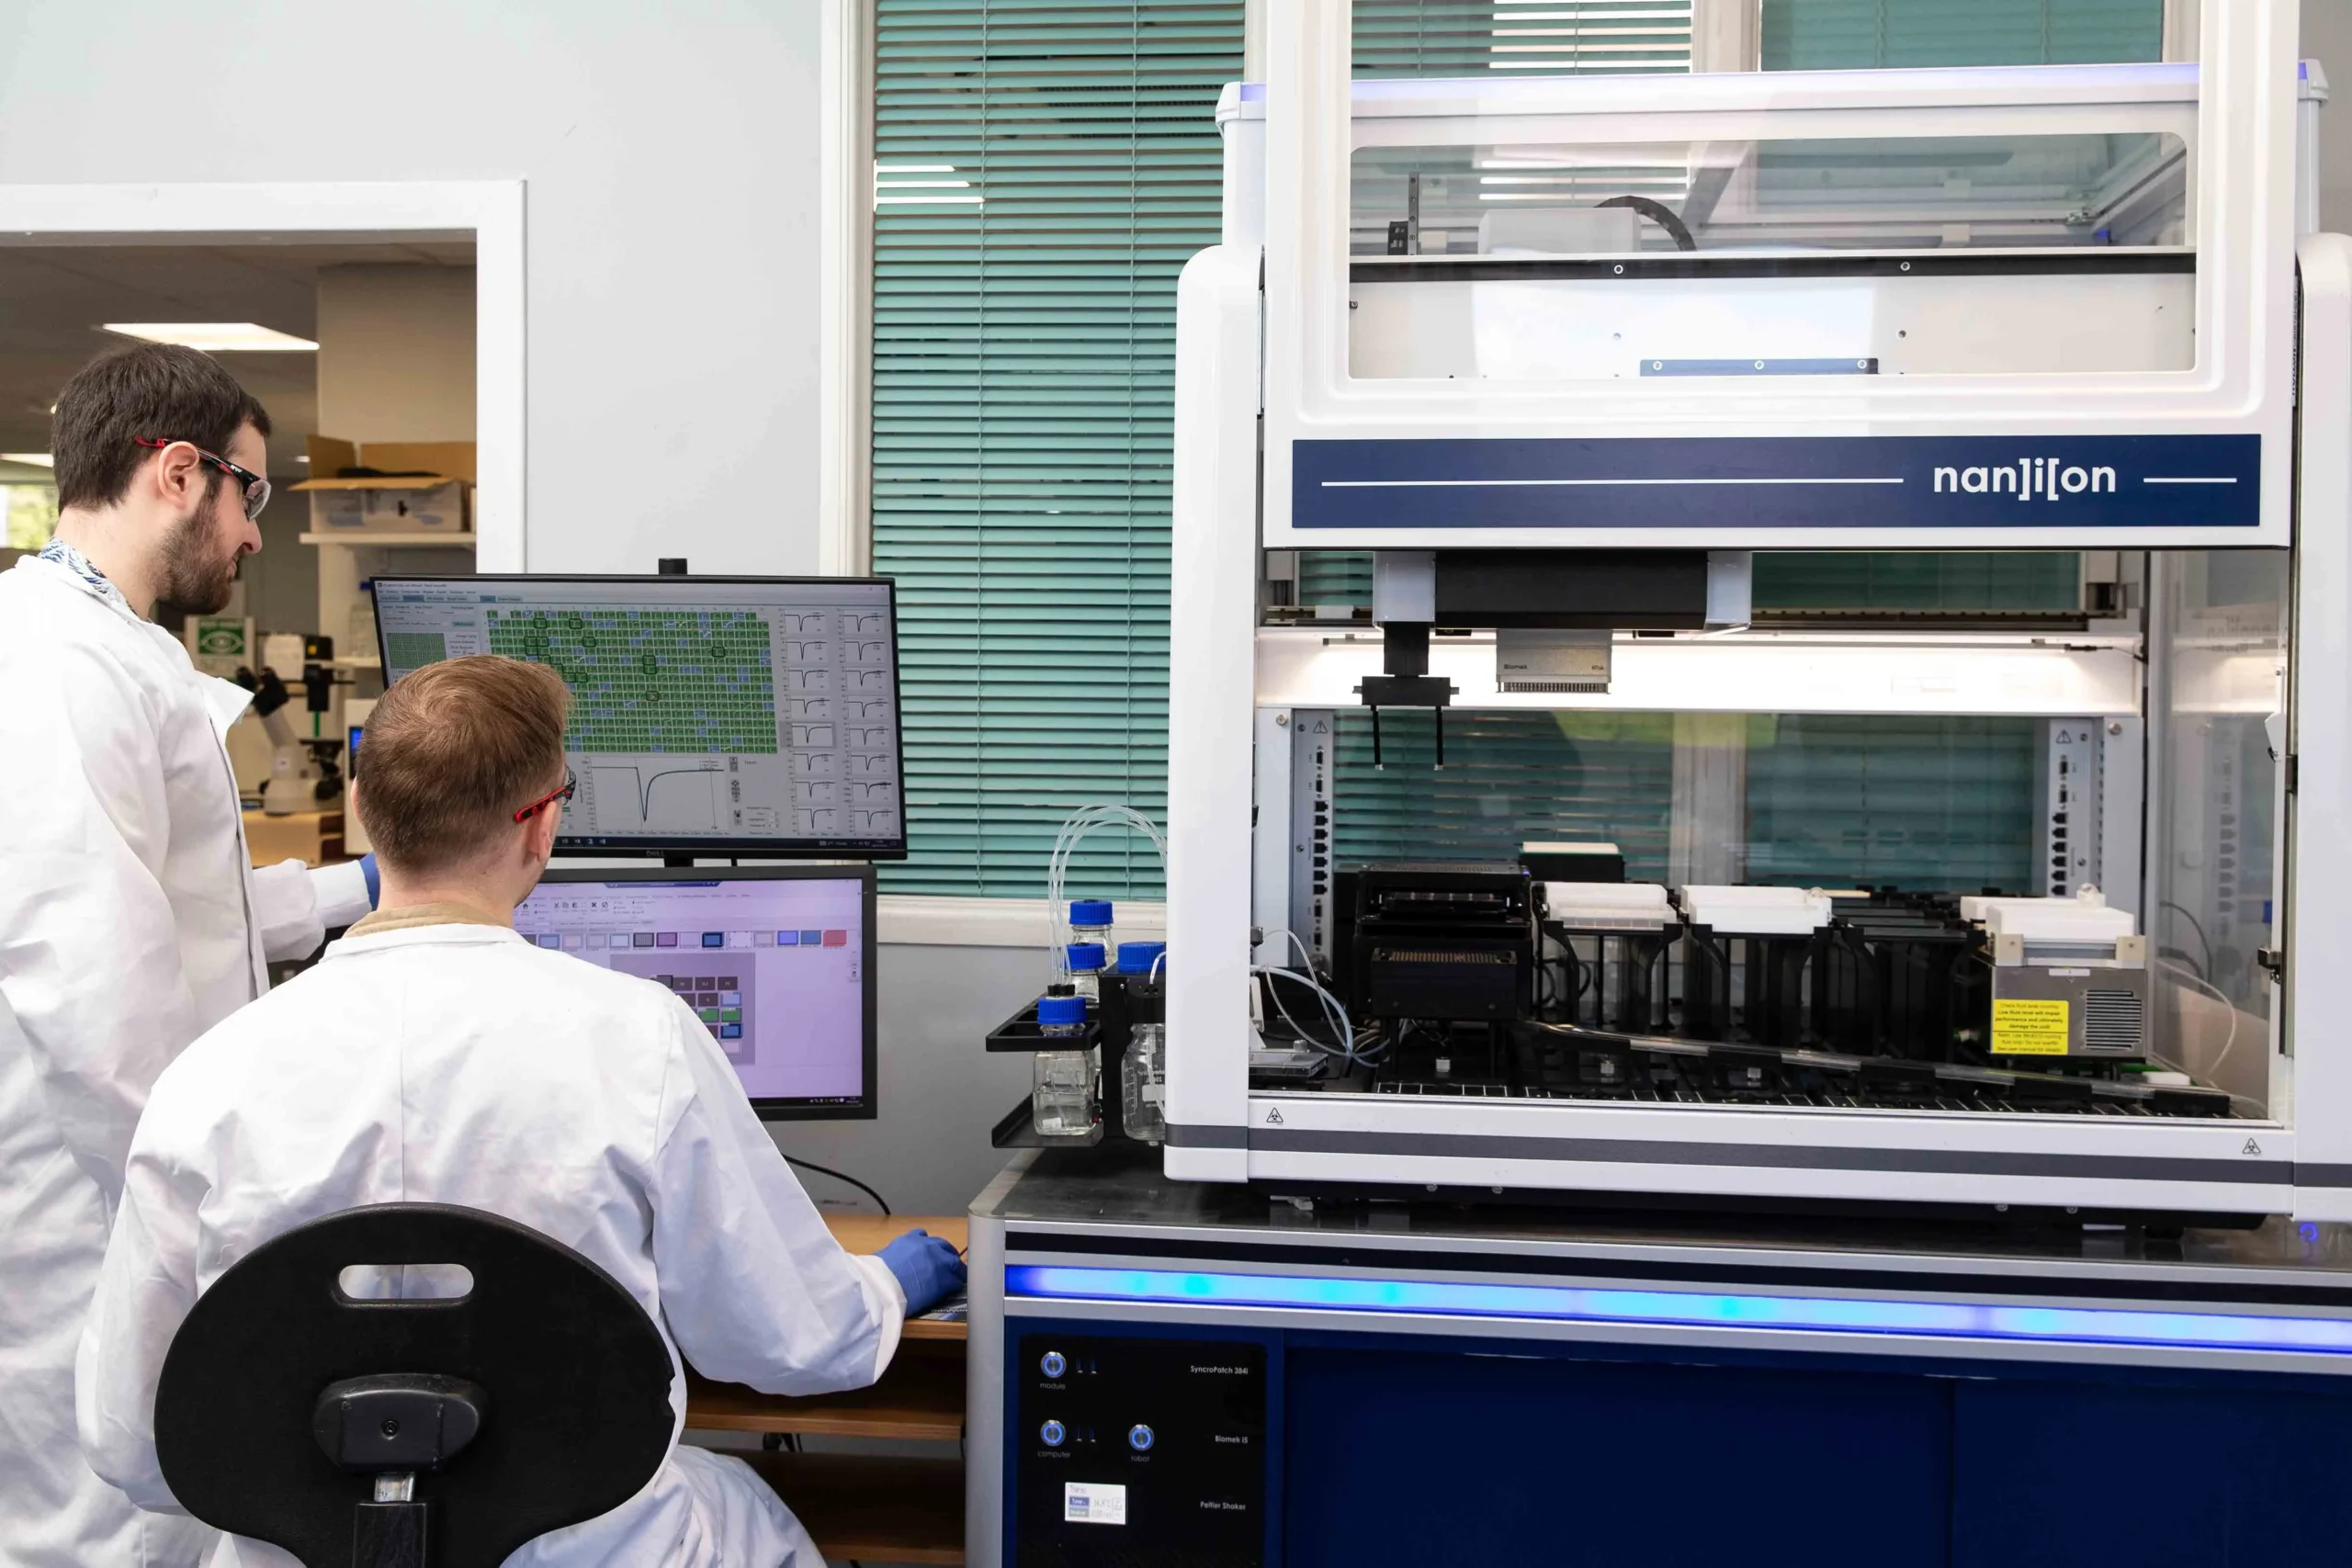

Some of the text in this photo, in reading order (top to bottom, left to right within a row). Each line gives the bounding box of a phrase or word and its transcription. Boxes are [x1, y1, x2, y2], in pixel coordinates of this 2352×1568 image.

[1190, 1365, 1233, 1374] SyncroPatch
[1039, 1382, 1066, 1390] module
[1215, 1434, 1240, 1443] Biomek
[1036, 1450, 1071, 1459] computer
[1131, 1454, 1150, 1462] robot
[1222, 1502, 1246, 1510] Shaker
